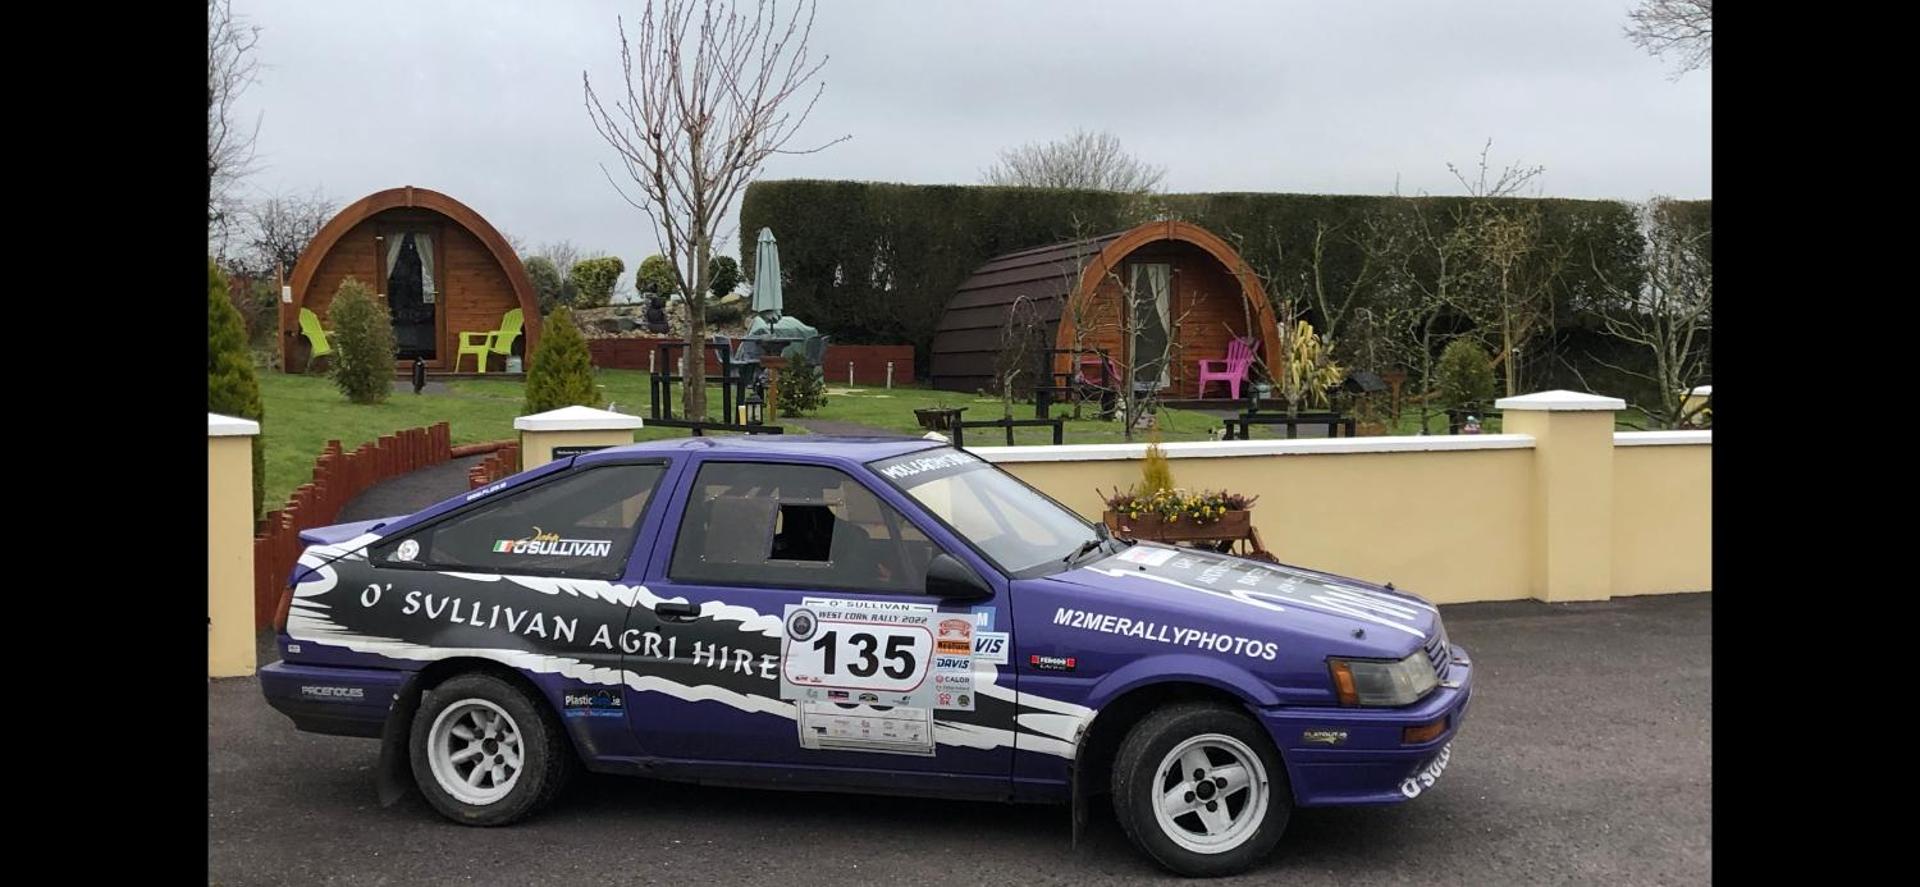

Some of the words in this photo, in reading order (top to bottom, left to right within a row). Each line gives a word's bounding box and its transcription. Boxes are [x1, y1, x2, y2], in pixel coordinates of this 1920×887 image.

[847, 601, 910, 611] SULLIVAN
[819, 611, 842, 619] WEST
[845, 613, 869, 621] CORK
[872, 614, 900, 623] RALLY
[901, 616, 928, 624] 2022
[360, 583, 393, 608] O'
[402, 591, 579, 643] SULLIVAN
[590, 624, 677, 661] AGRI
[692, 641, 780, 680] HIRE
[1053, 607, 1278, 660] M2MERALLYPHOTOS
[813, 631, 916, 680] 135
[936, 658, 970, 669] DAVIS
[302, 686, 363, 697] PACENOTES
